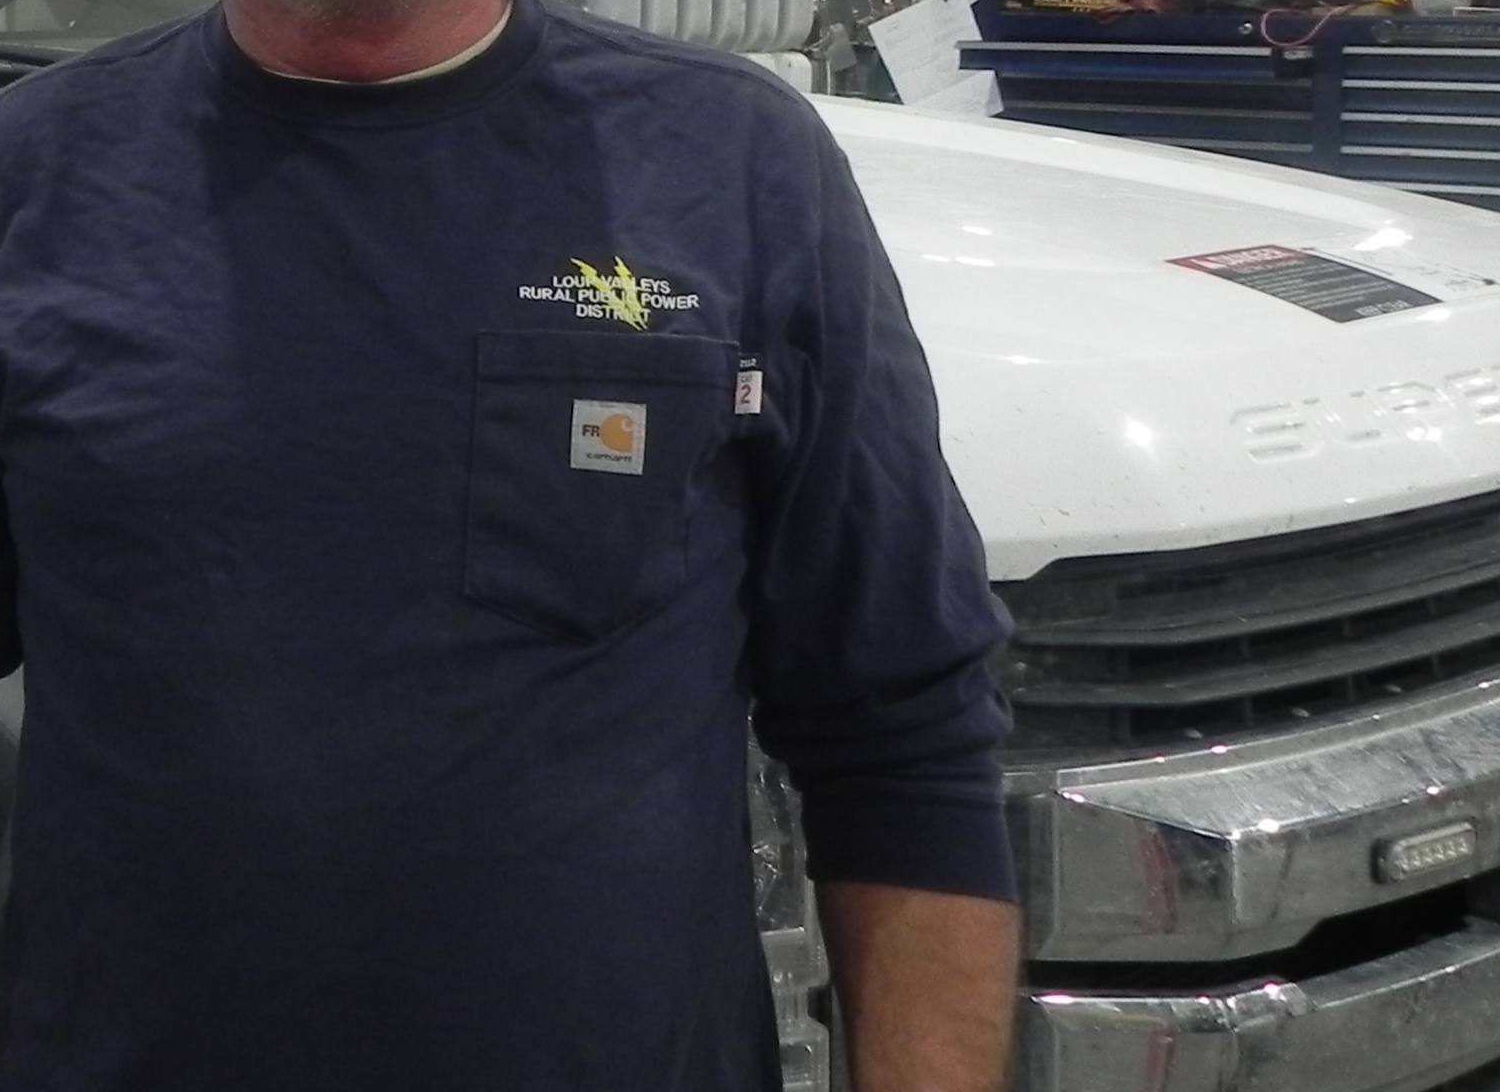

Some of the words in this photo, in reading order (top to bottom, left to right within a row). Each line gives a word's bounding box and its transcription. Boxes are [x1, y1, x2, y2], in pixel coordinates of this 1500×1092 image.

[519, 286, 575, 303] RURAL
[578, 288, 638, 307] PUBLIC
[641, 292, 700, 310] POWER
[576, 303, 652, 323] DISTRICT
[739, 383, 752, 406] 2
[1227, 365, 1500, 464] SUPE
[582, 424, 601, 438] FR
